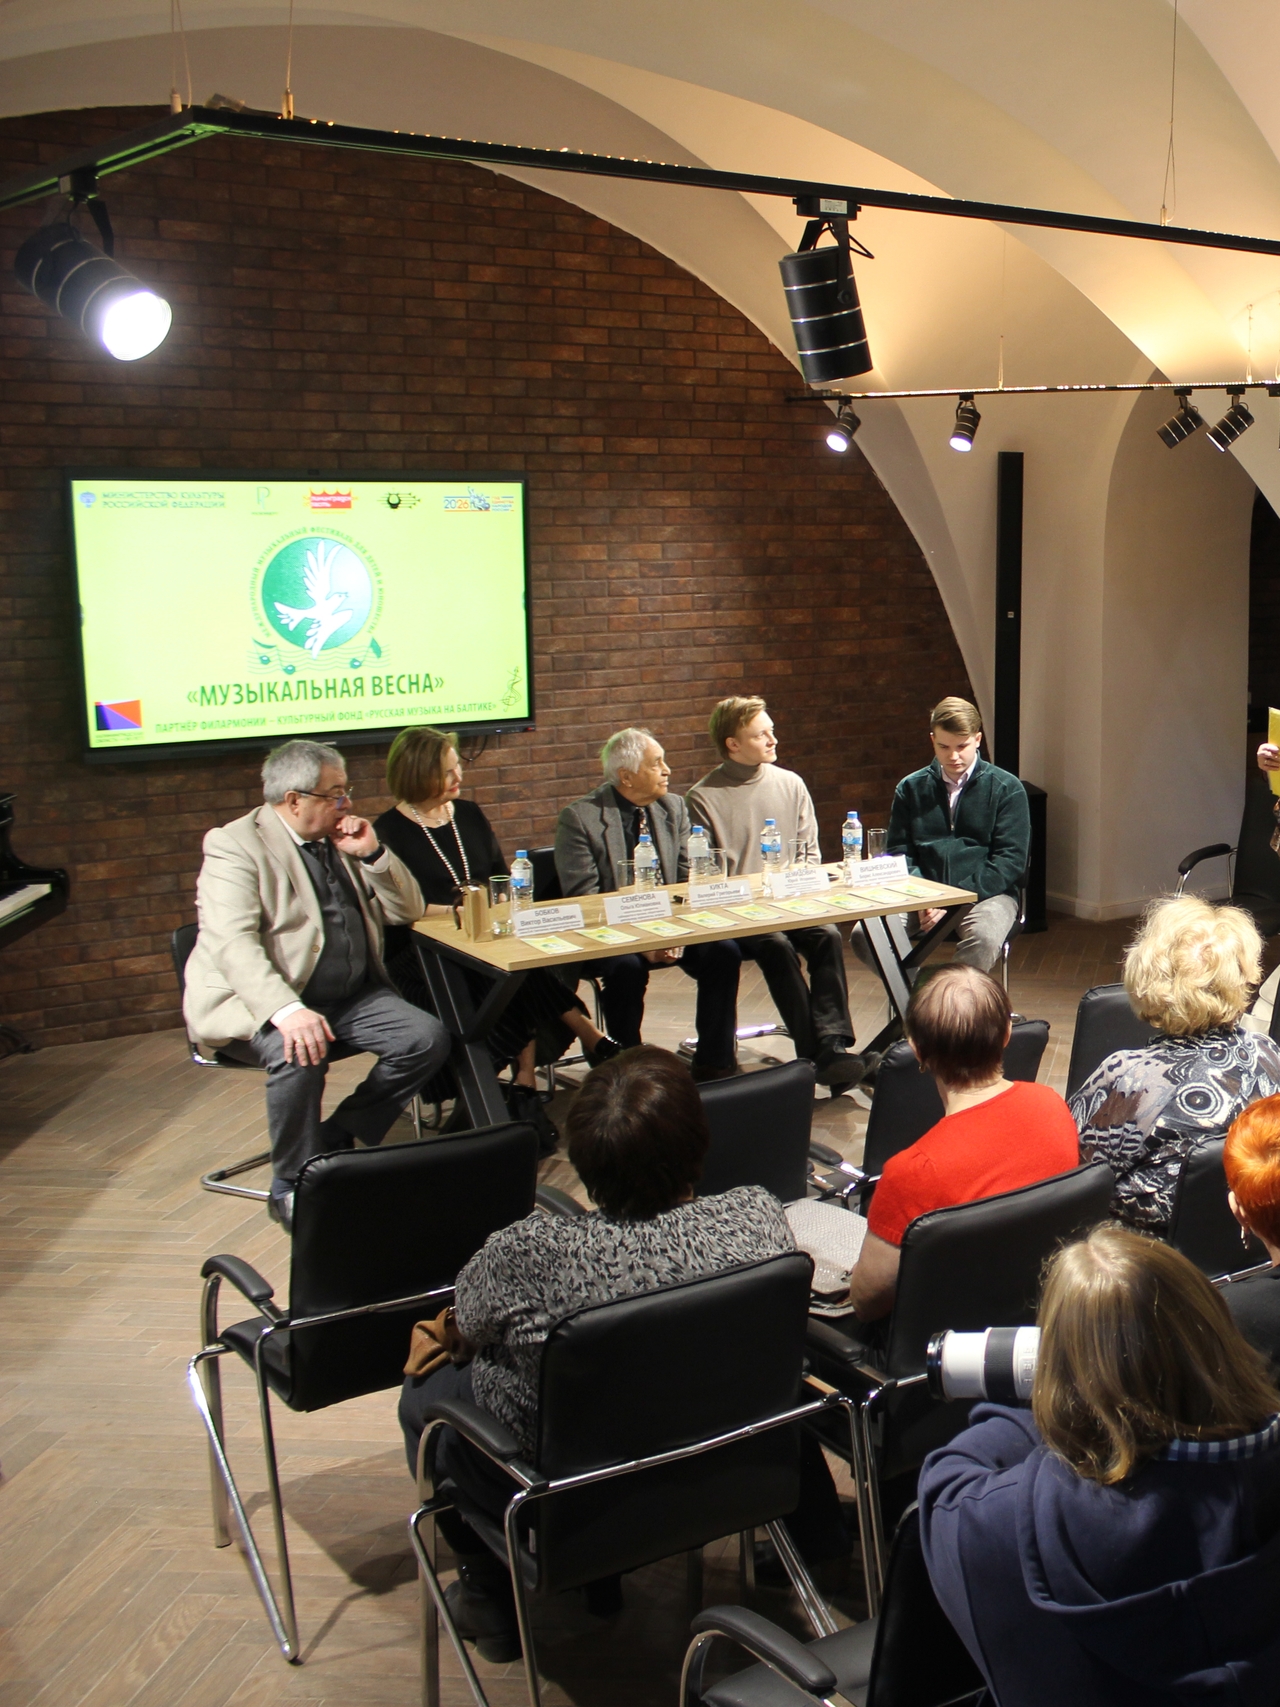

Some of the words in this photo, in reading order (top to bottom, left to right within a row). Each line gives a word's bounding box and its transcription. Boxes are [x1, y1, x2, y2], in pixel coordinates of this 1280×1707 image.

[444, 499, 469, 509] 2026
[187, 676, 364, 706] «МУЗЫКАЛЬНАЯ
[372, 673, 444, 696] ВЕСНА»
[155, 720, 197, 733] ПАРТНЁР
[200, 717, 266, 730] ФИЛАРМОНИИ
[277, 711, 335, 725] КУЛЬТУРНЫЙ
[337, 711, 363, 722] ФОНД
[365, 707, 405, 718] «РУССКАЯ
[407, 705, 442, 717] МУЗЫКА
[444, 704, 454, 713] НА
[457, 702, 497, 713] БАЛТИКЕ»
[860, 861, 898, 873] ВИШНЕВСКИЙ
[534, 907, 559, 916] БОБКОВ
[520, 919, 541, 927] Виктор
[542, 914, 576, 924] Васильевич
